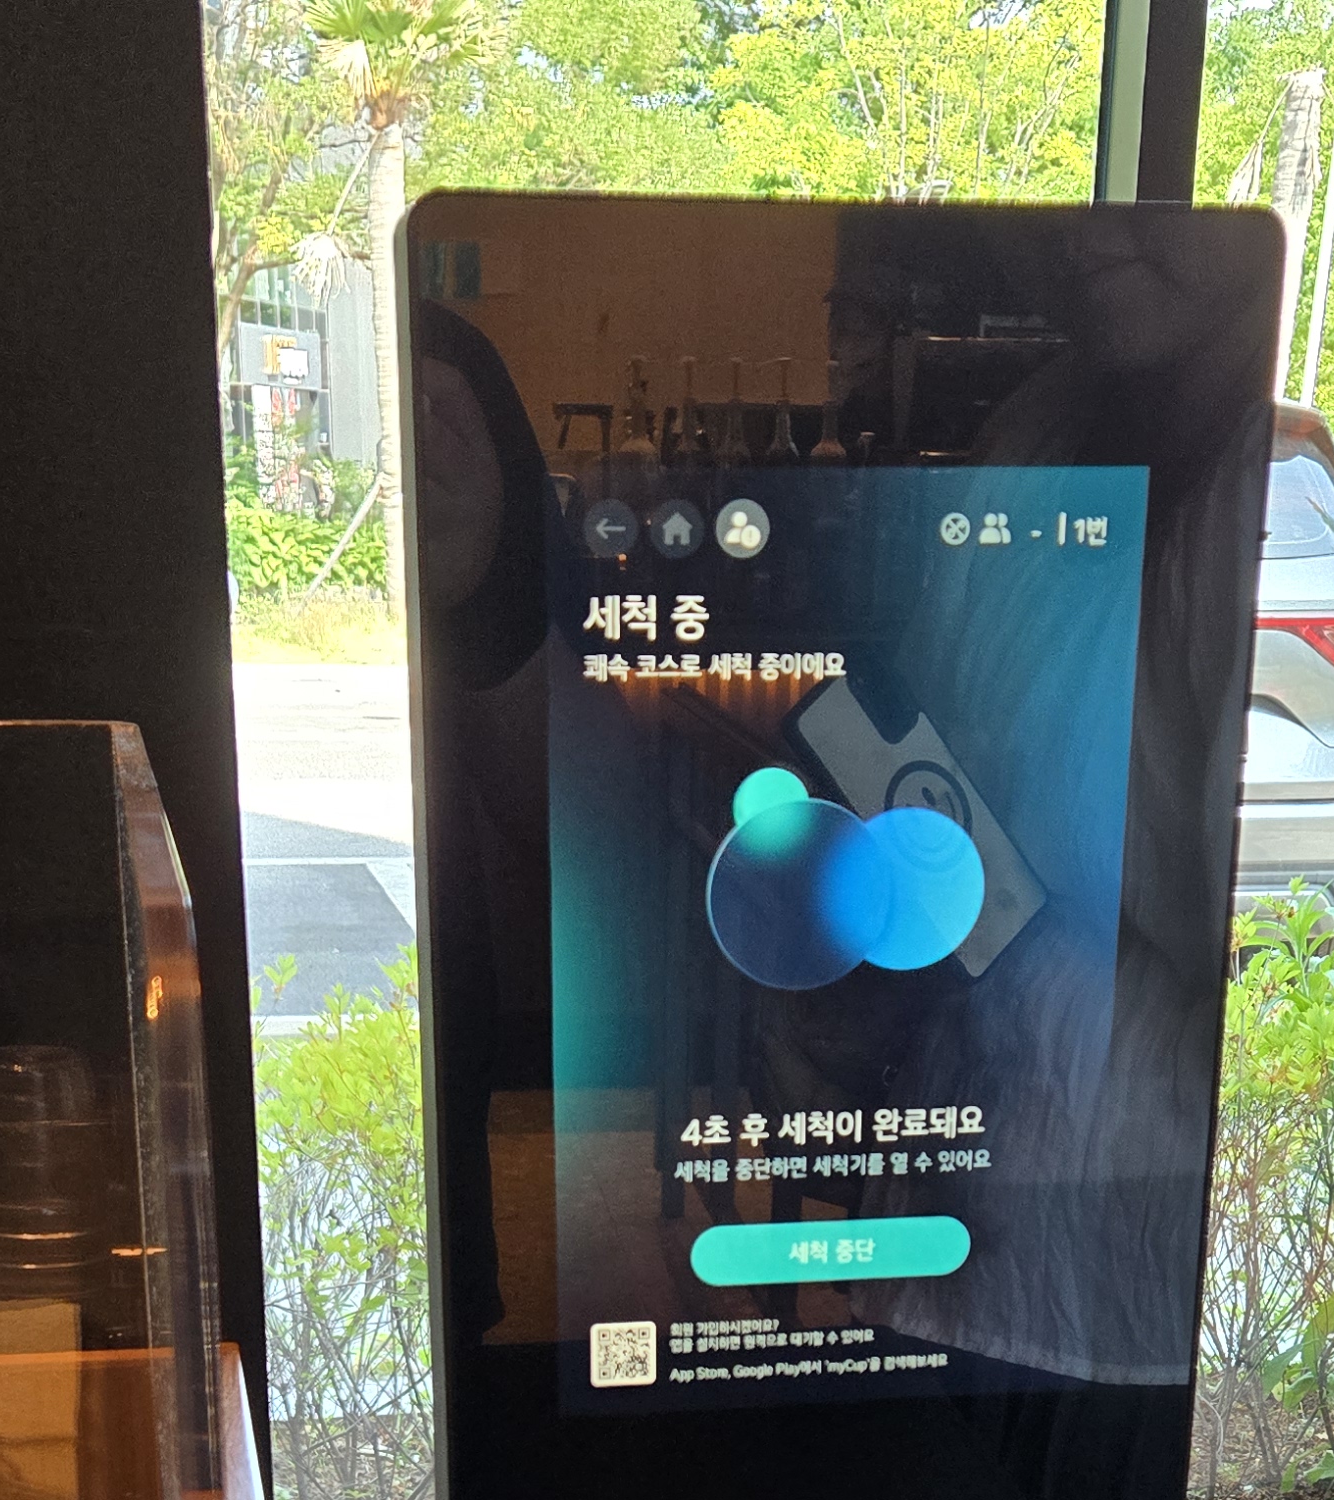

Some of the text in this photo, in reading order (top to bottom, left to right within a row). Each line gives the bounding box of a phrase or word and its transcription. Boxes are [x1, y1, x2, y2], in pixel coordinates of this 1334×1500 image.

[583, 594, 710, 641] 세척 중
[583, 651, 846, 682] 쾌속 코스로 세척 중이에요
[680, 1105, 986, 1147] 4초 후 세척이 완료돼요
[674, 1149, 993, 1183] 세척을 중단하면 세척기를 열 수 있어요
[788, 1237, 877, 1264] 세척 중단
[669, 1368, 695, 1383] App
[732, 1363, 774, 1380] Google
